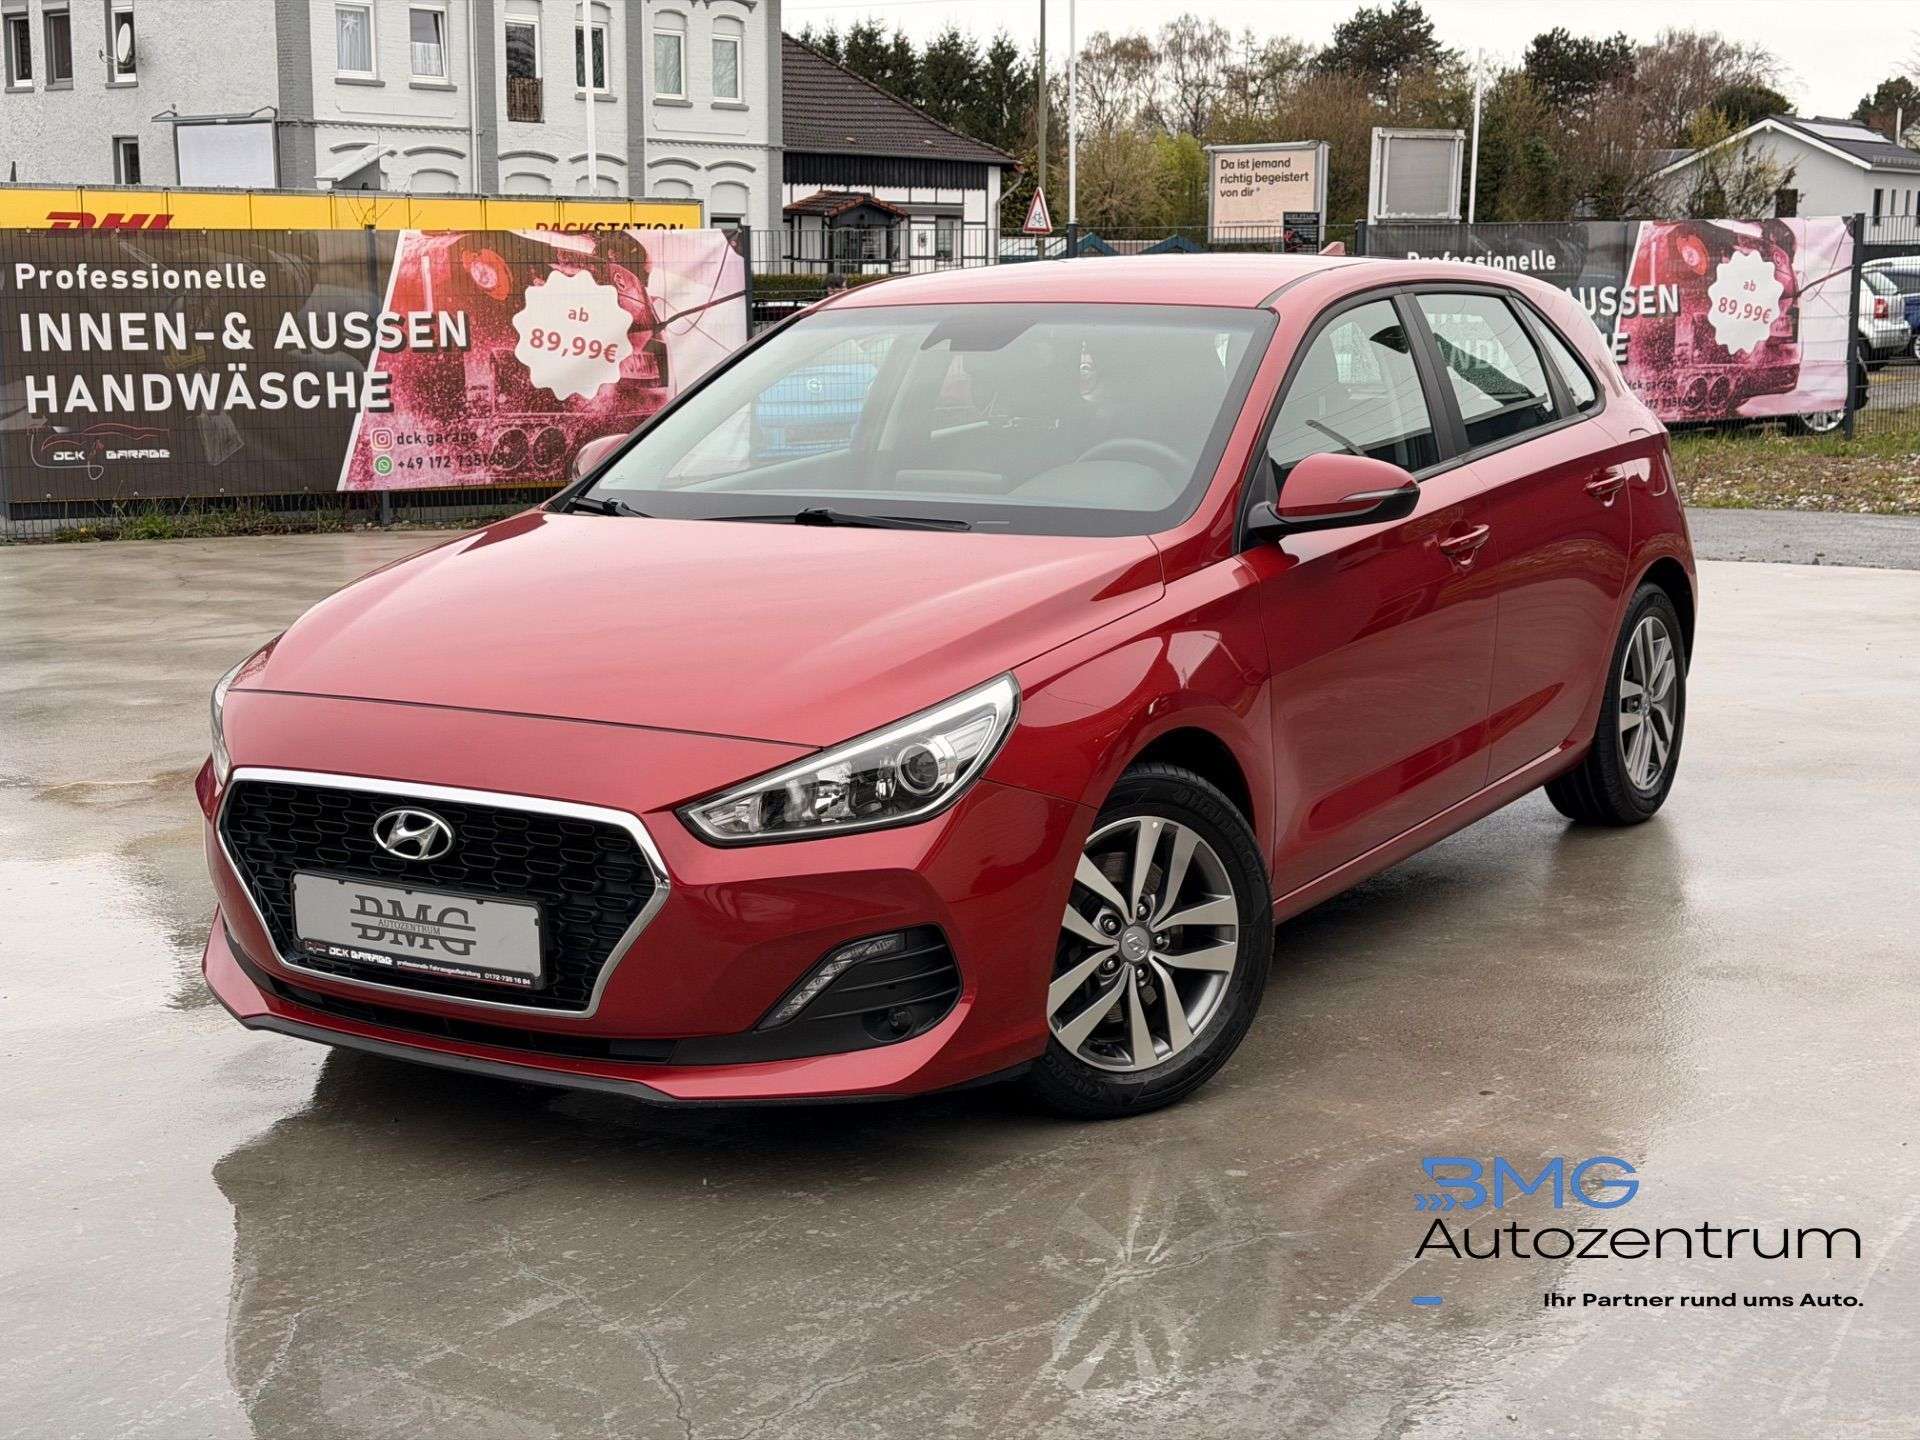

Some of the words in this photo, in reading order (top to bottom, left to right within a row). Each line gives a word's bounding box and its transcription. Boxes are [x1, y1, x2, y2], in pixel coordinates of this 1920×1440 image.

[1220, 159, 1235, 170] Da
[1237, 158, 1250, 170] ist
[1251, 157, 1291, 171] jemand
[1220, 173, 1253, 185] richtig
[1255, 171, 1309, 185] begeistert
[1220, 189, 1239, 198] von
[15, 263, 267, 290] Professionelle
[1743, 280, 1757, 292] ab
[567, 305, 590, 323] ab
[1718, 296, 1772, 324] 89,99€
[274, 310, 468, 350] AUSSEN
[529, 327, 619, 363] 89,99€
[25, 362, 392, 413] HANDWÄSCHE
[398, 456, 423, 470] +49
[429, 456, 450, 469] 172
[350, 894, 477, 956] BMG
